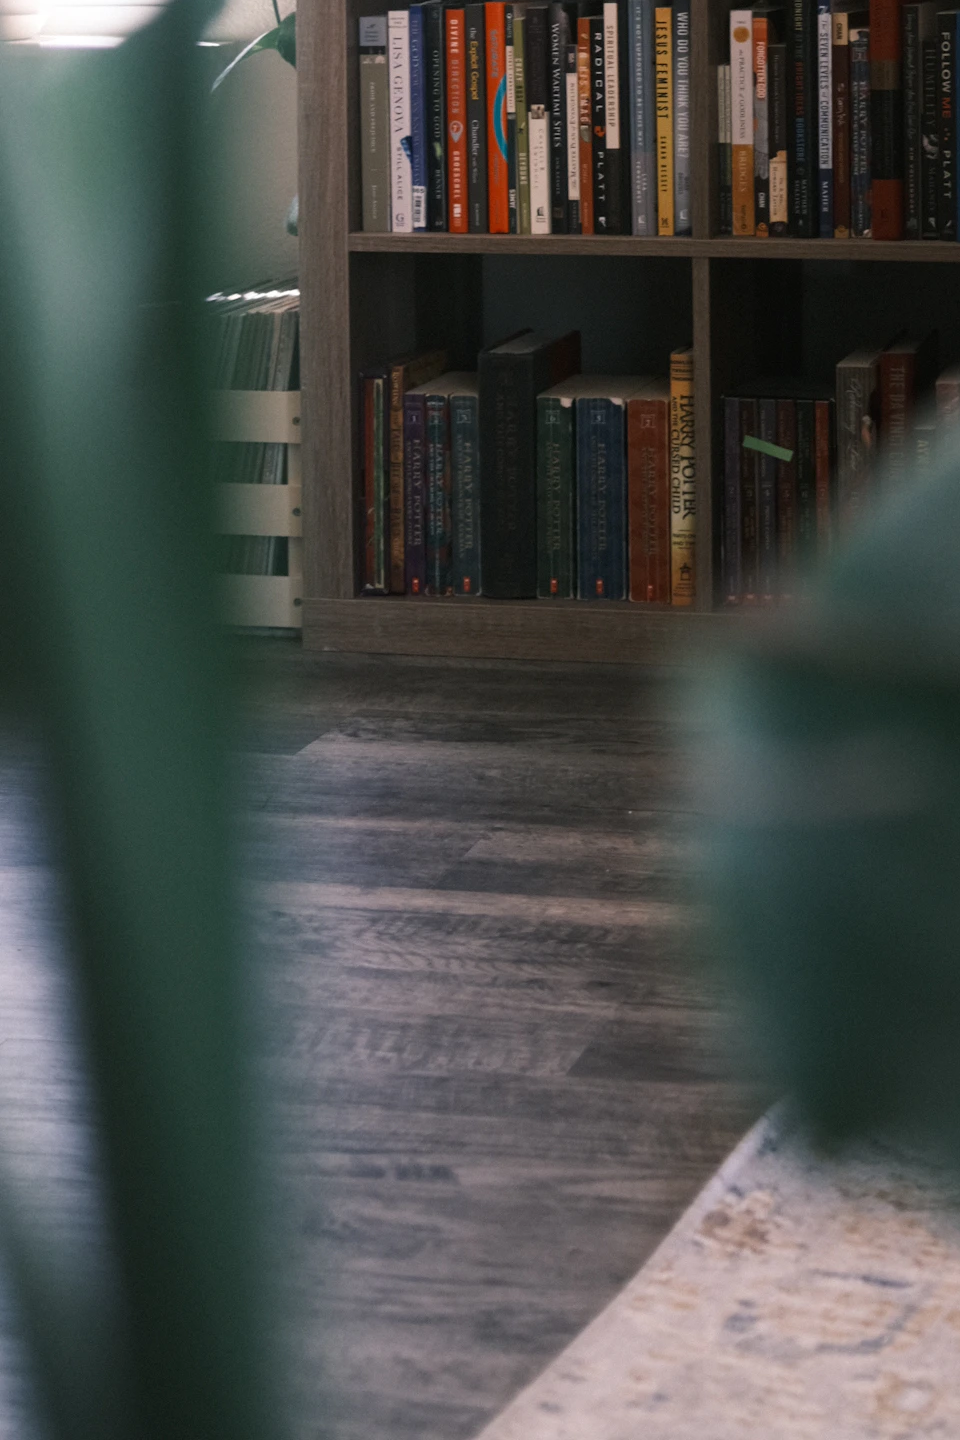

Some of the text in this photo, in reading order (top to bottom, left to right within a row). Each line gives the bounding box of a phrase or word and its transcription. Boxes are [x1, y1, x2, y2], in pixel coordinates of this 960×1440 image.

[393, 37, 403, 69] LISA
[450, 19, 460, 113] DIVINE DIRECTION
[469, 41, 479, 69] Explicit
[490, 30, 498, 78] SATURATE
[820, 33, 829, 57] SEVEN
[432, 50, 442, 138] OPENING TO GOD
[470, 72, 480, 100] Gospel
[515, 58, 524, 103] CRAZY BUSY
[551, 23, 562, 147] WOMEN WARTIME SPIES
[579, 67, 589, 86] HIS
[594, 33, 604, 113] RADICAL
[607, 26, 616, 127] SPIRITUAL LEADERSHIP
[636, 86, 642, 95] TO
[656, 21, 669, 119] JESUS FEMINIST
[677, 12, 689, 158] WHO DO YOU THINK YOU ARE?
[756, 41, 766, 99] FORGOTTEN GOD
[795, 62, 804, 91] BRIGHT
[820, 61, 829, 89] LEVELS
[925, 49, 936, 126] HUMILITY
[941, 32, 951, 119] FOLLOW ME
[393, 76, 403, 133] GENOVA
[580, 94, 591, 130] IMAGE
[637, 98, 642, 108] BE
[796, 93, 805, 115] IDEAS
[859, 81, 867, 174] HARRY POTTER
[472, 120, 480, 156] Chandler
[796, 118, 805, 162] BOOKSTORE
[820, 100, 830, 165] COMMUNICATION
[453, 151, 461, 198] GROESCHEL
[519, 153, 528, 185] DEYOUNG
[597, 152, 605, 202] PLATT
[943, 150, 951, 199] PLATT
[821, 181, 829, 212] MAHER
[680, 395, 695, 449] HARRY
[890, 367, 905, 446] THE DA VINCI
[435, 444, 443, 487] HARRY
[598, 443, 606, 493] HARRY
[671, 429, 680, 473] CURSED
[413, 439, 422, 546] HARRY POTTER
[464, 442, 473, 549] HARRY POTTER
[648, 448, 657, 555] HARRY POTTER
[672, 477, 680, 514] CHILD
[681, 457, 696, 520] POTTER
